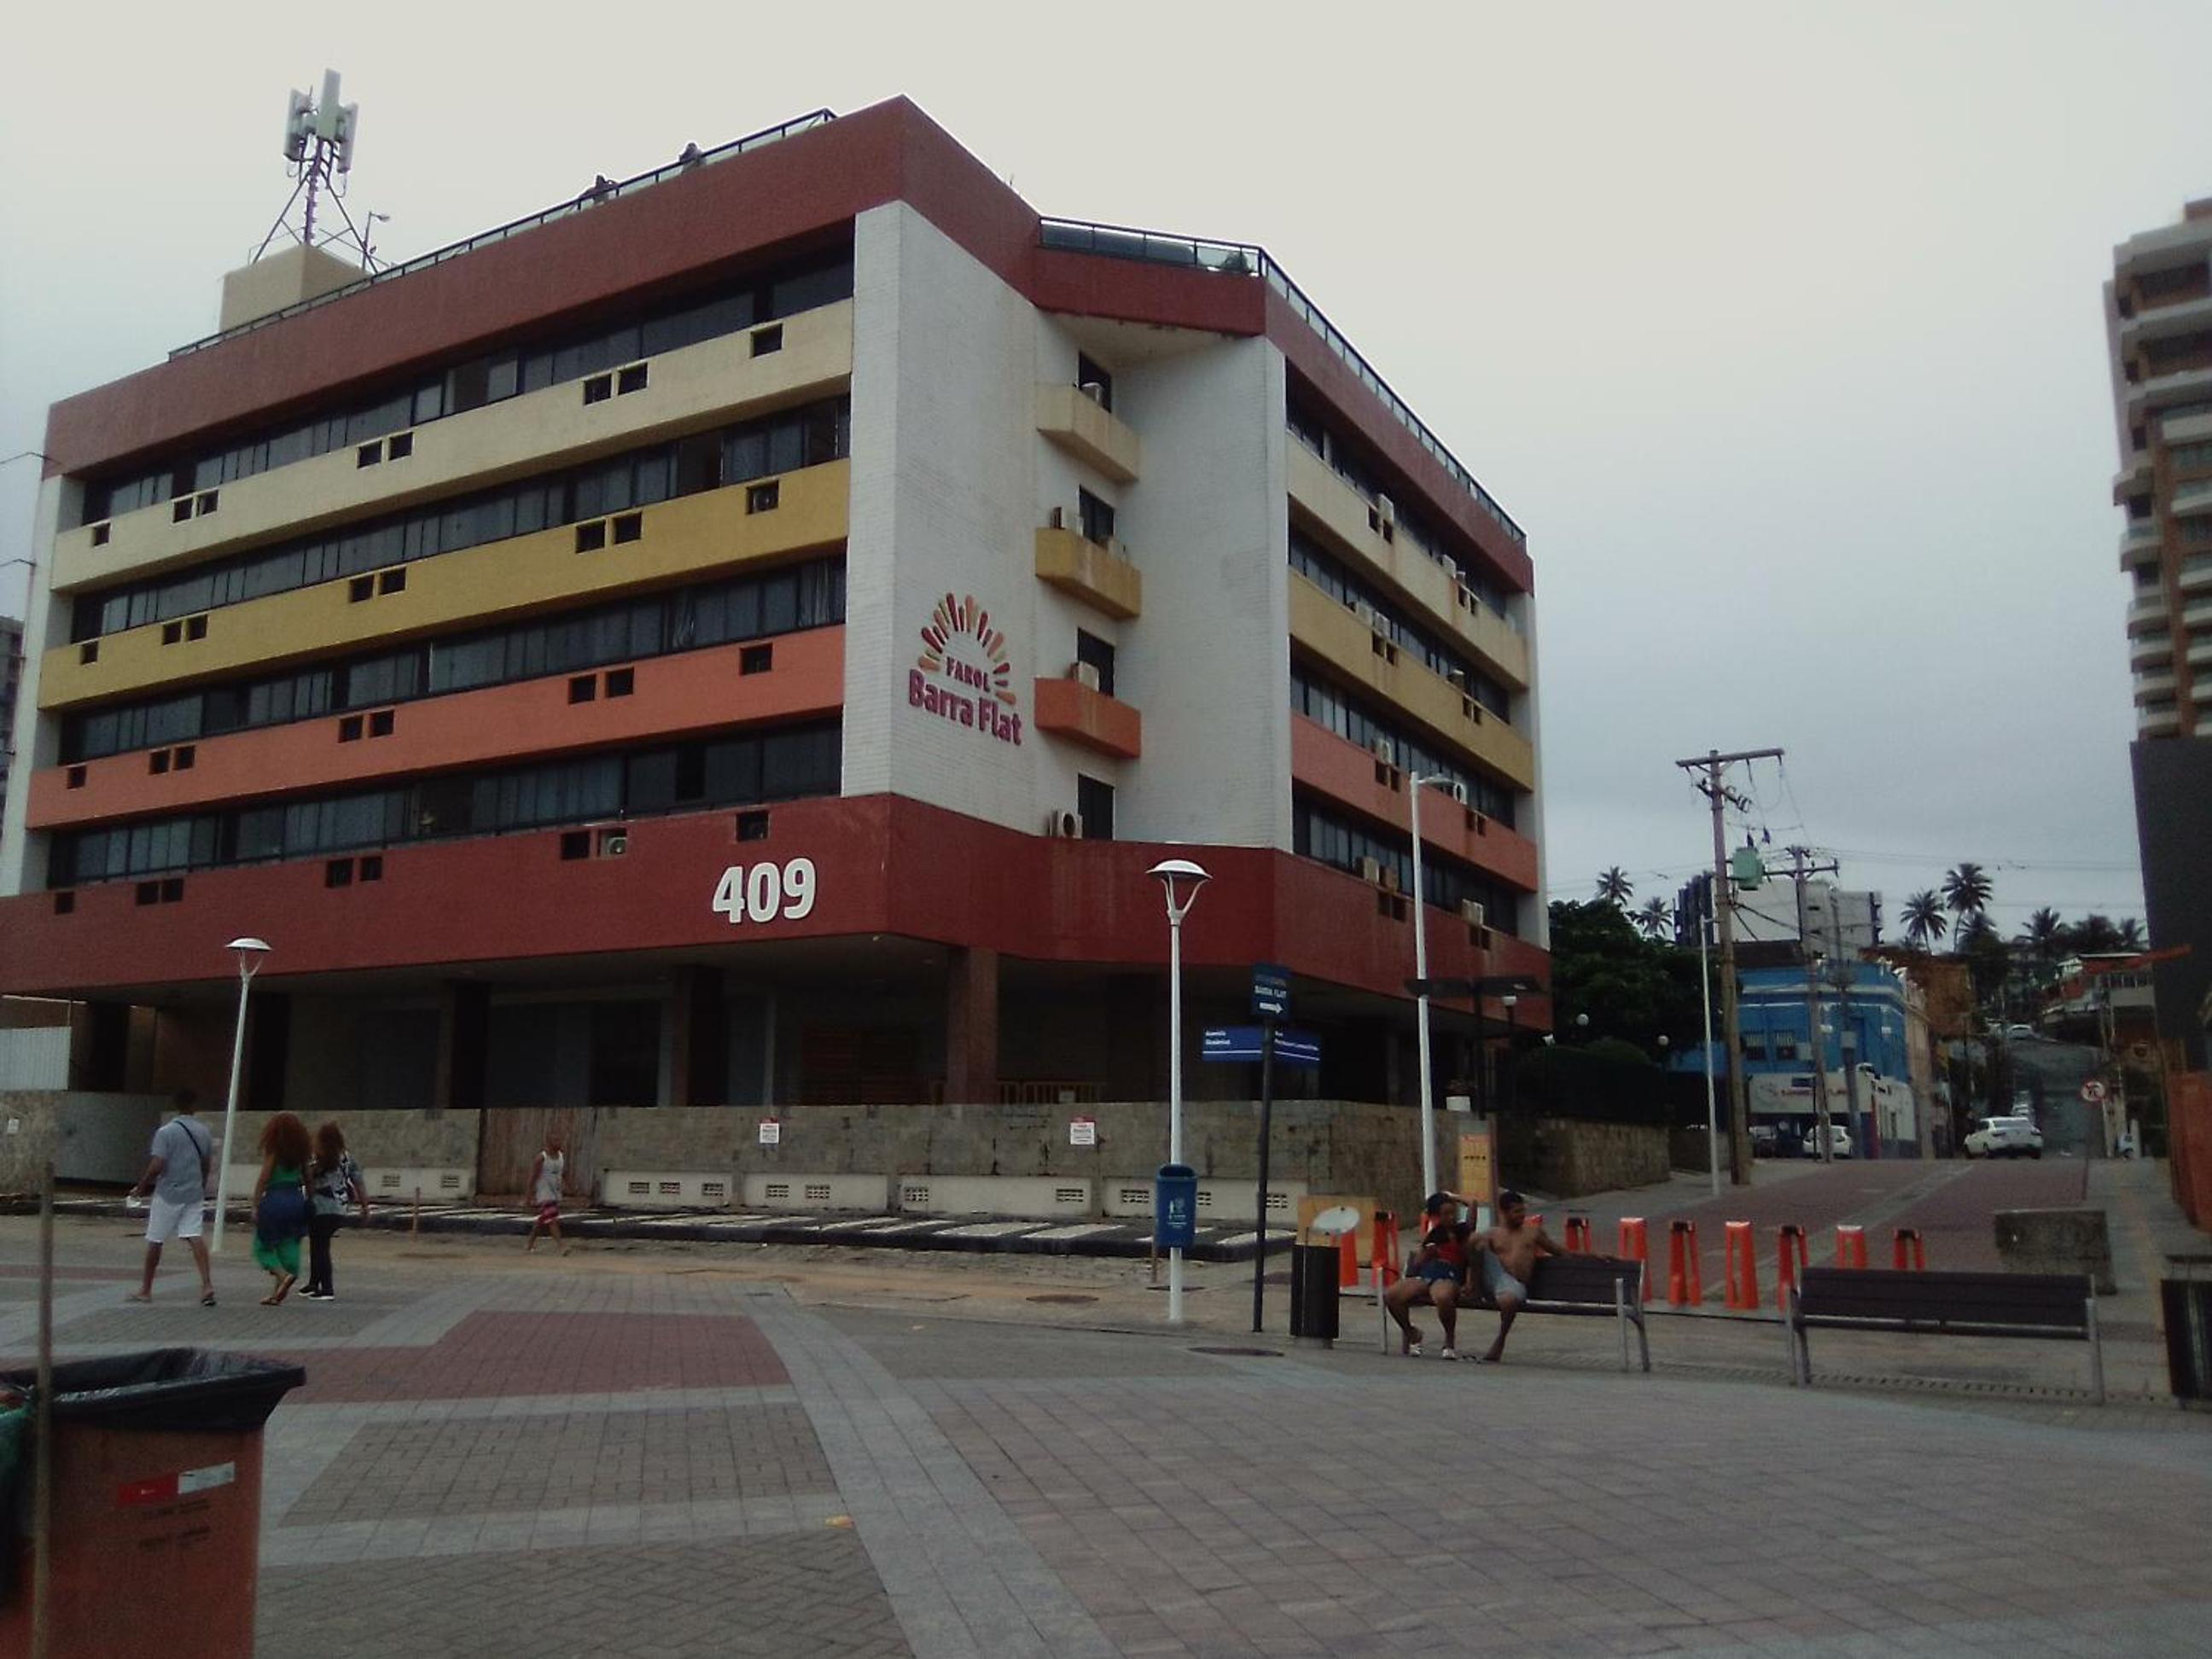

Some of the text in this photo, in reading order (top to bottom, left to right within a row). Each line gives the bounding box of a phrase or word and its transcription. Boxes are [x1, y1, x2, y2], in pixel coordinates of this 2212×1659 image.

[946, 656, 991, 693] FAROL
[909, 669, 1022, 746] Barra Flat
[713, 858, 816, 923] 409
